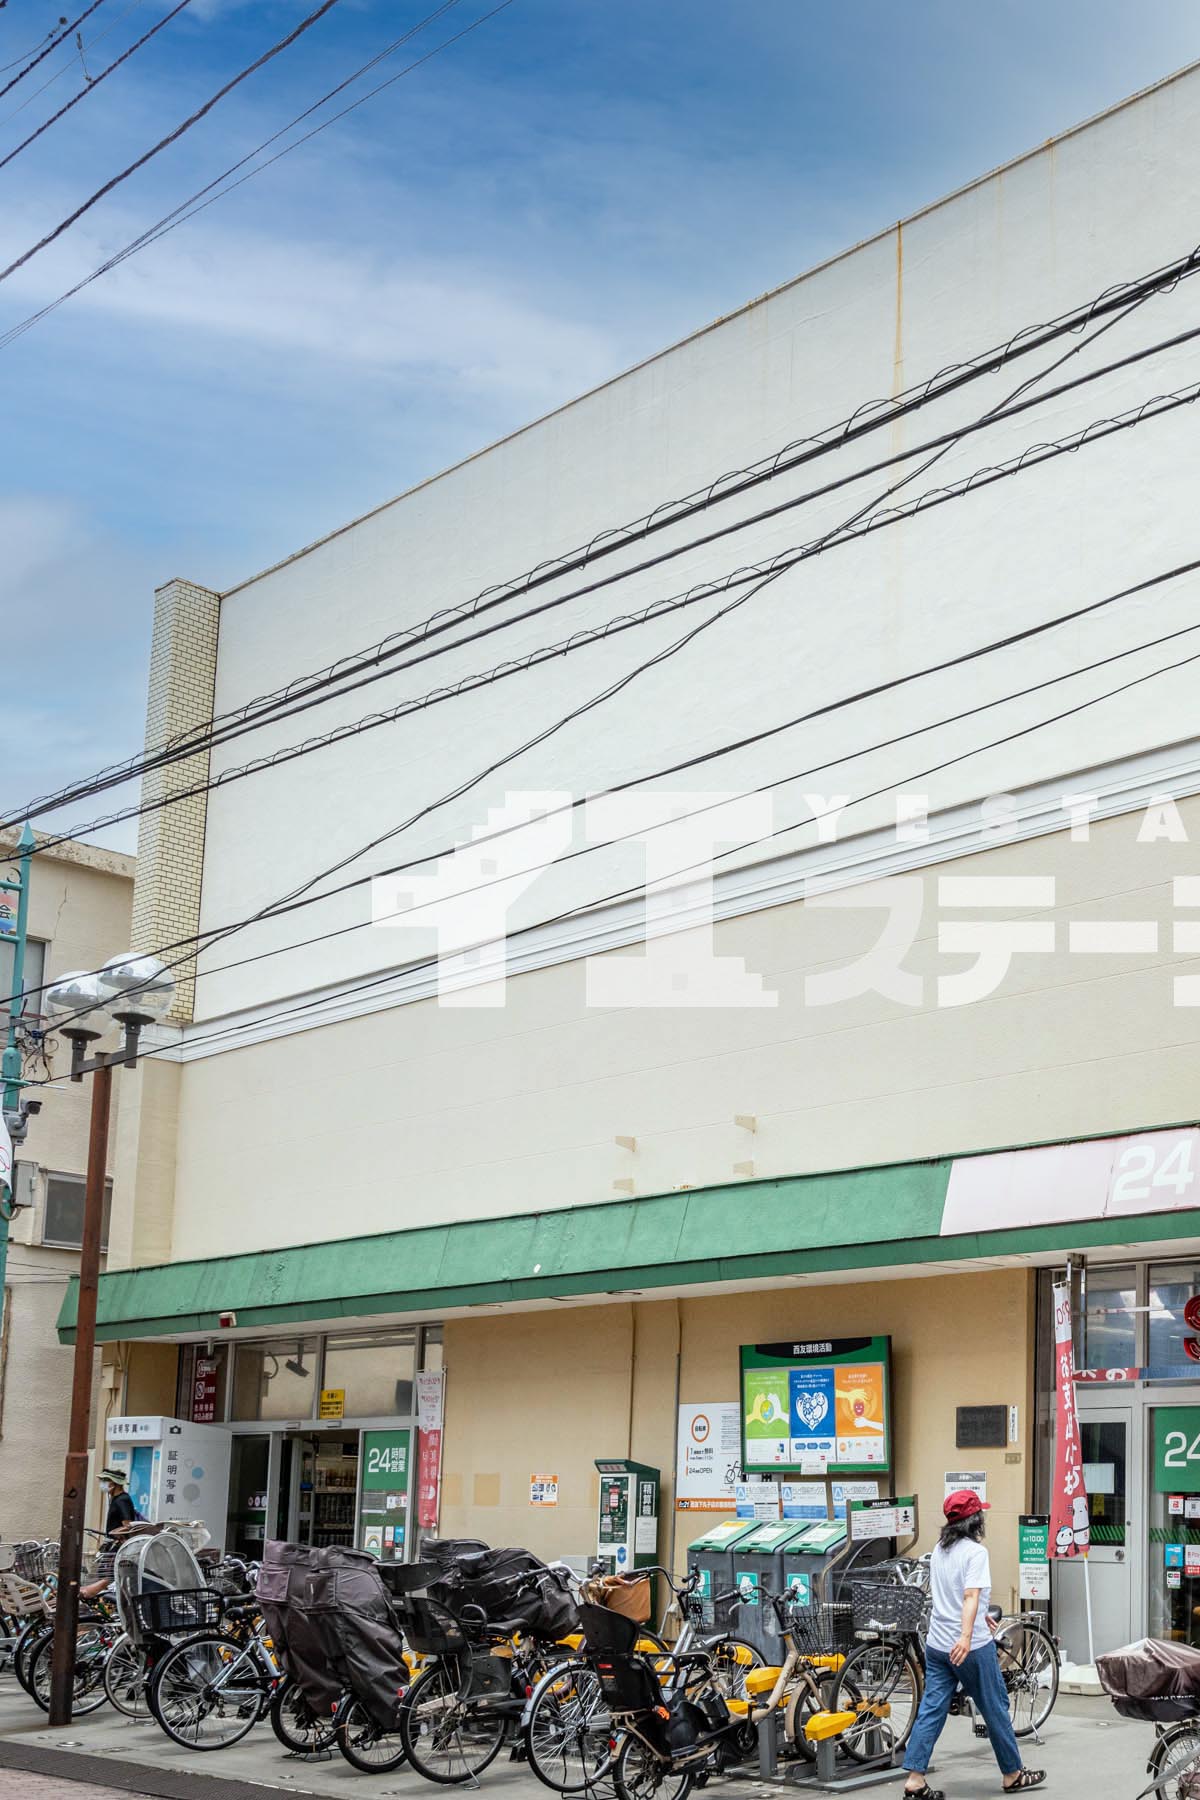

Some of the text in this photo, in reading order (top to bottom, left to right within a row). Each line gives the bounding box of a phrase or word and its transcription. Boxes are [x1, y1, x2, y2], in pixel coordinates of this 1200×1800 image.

[165, 1450, 178, 1505] 証明写真
[368, 1447, 391, 1473] 24
